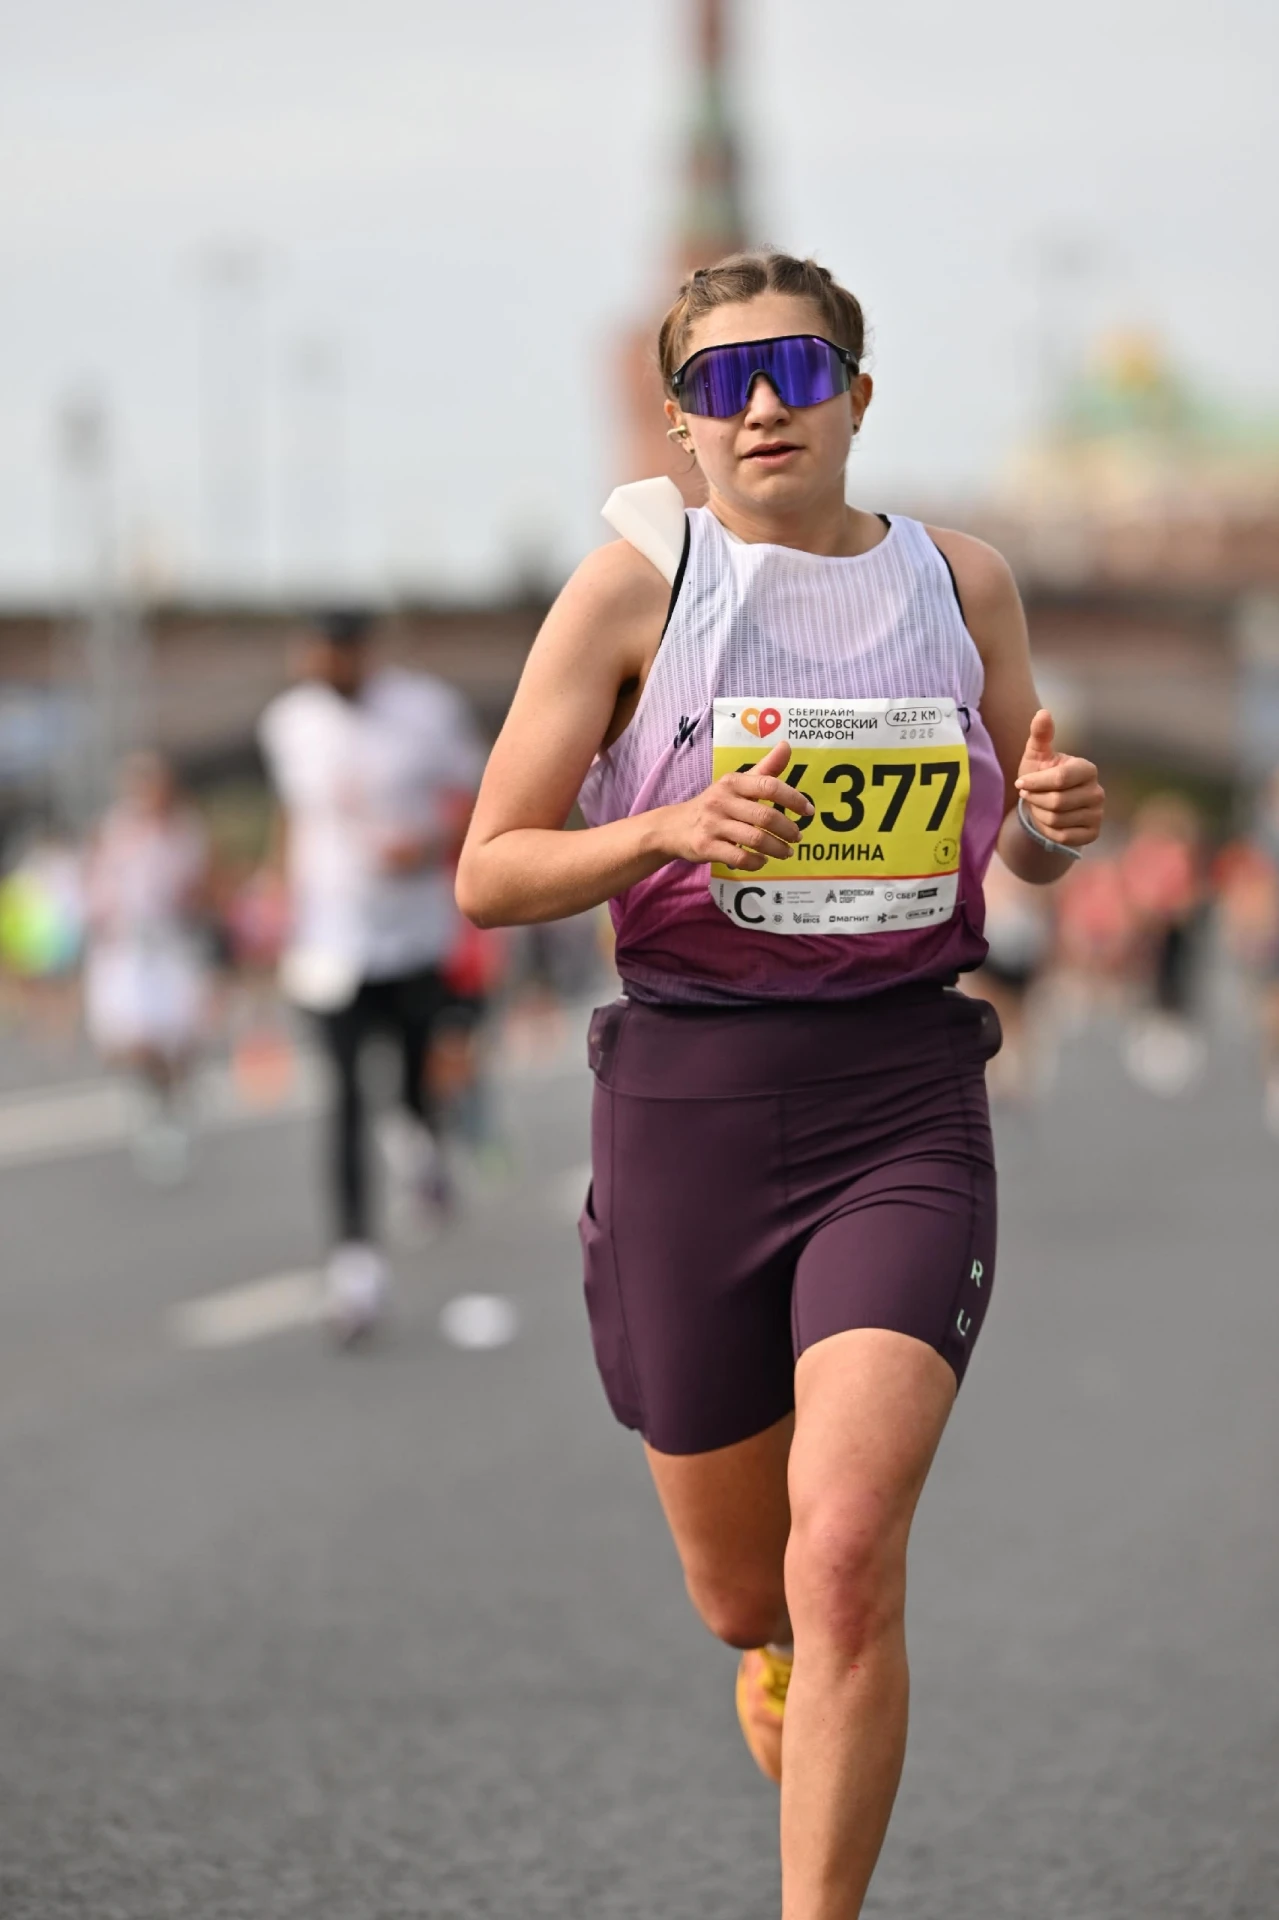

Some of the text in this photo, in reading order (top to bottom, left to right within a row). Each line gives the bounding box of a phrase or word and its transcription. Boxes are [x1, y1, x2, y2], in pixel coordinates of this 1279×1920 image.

[788, 708, 855, 717] СБЕРПРАЙМ
[893, 710, 936, 724] 42,2 КМ
[788, 717, 878, 729] МОСКОВСКИЙ
[788, 730, 855, 740] МАРАФОН
[735, 761, 961, 833] 6377
[797, 843, 885, 862] ПОЛИНА
[942, 845, 949, 857] 1
